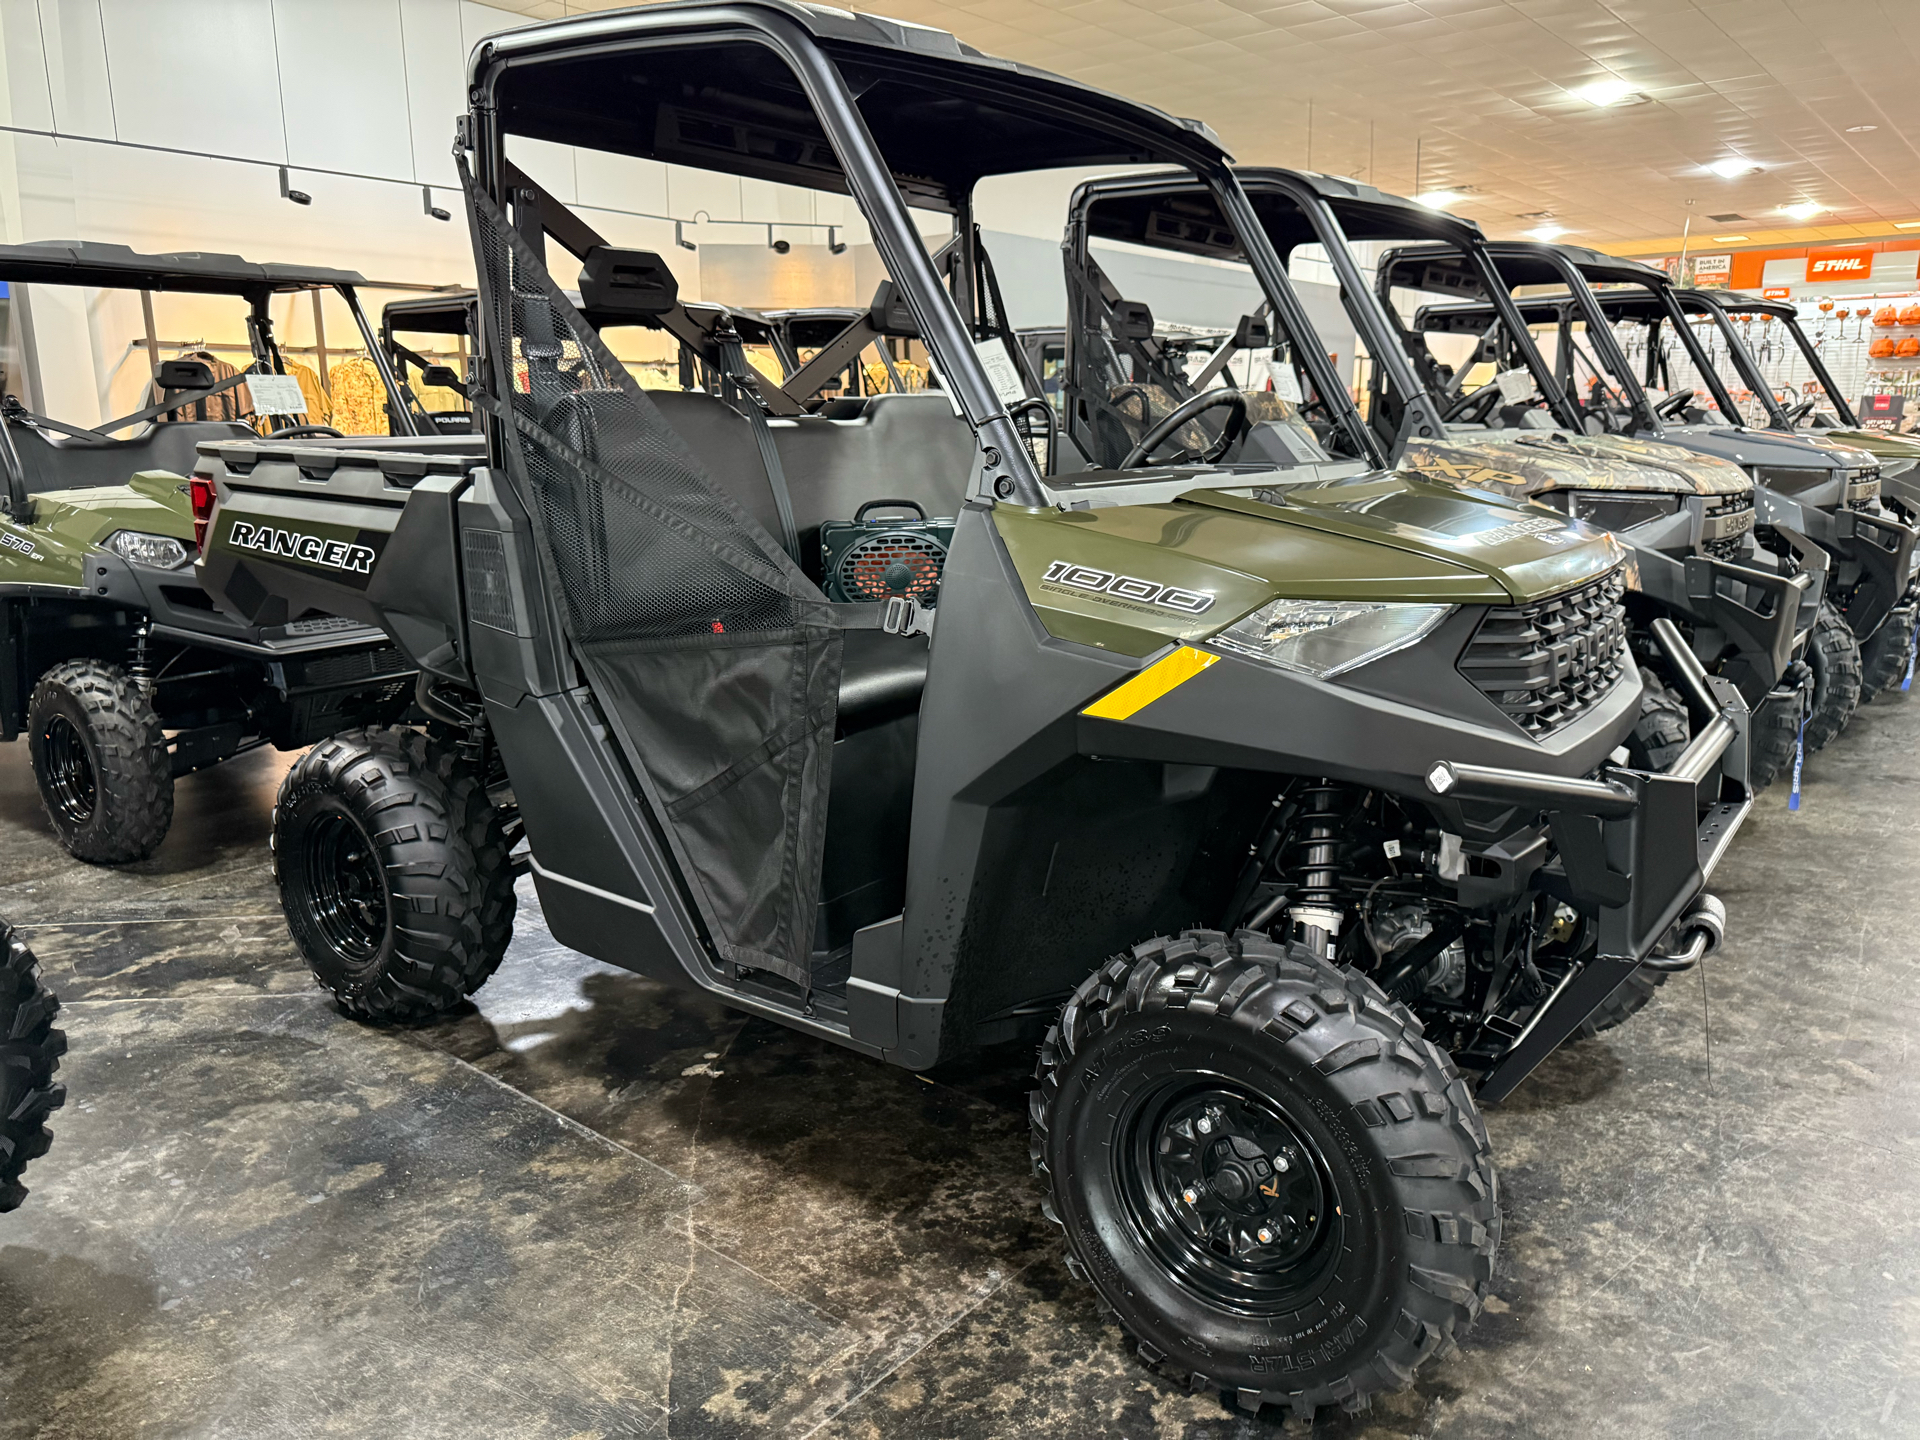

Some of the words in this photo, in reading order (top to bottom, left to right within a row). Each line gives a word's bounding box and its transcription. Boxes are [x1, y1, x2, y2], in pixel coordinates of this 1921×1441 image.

[1812, 258, 1868, 272] STIHL
[434, 416, 471, 424] POLARIS
[1415, 457, 1527, 486] XP
[0, 532, 35, 555] 570
[229, 521, 376, 574] RANGER
[1039, 583, 1090, 601] SINGLE
[1091, 595, 1164, 618] OVERHEAD
[1166, 611, 1201, 627] CAM
[1041, 560, 1216, 615] 1000
[1792, 742, 1804, 794] POLARIS
[1249, 1314, 1368, 1375] CARLSTAR
